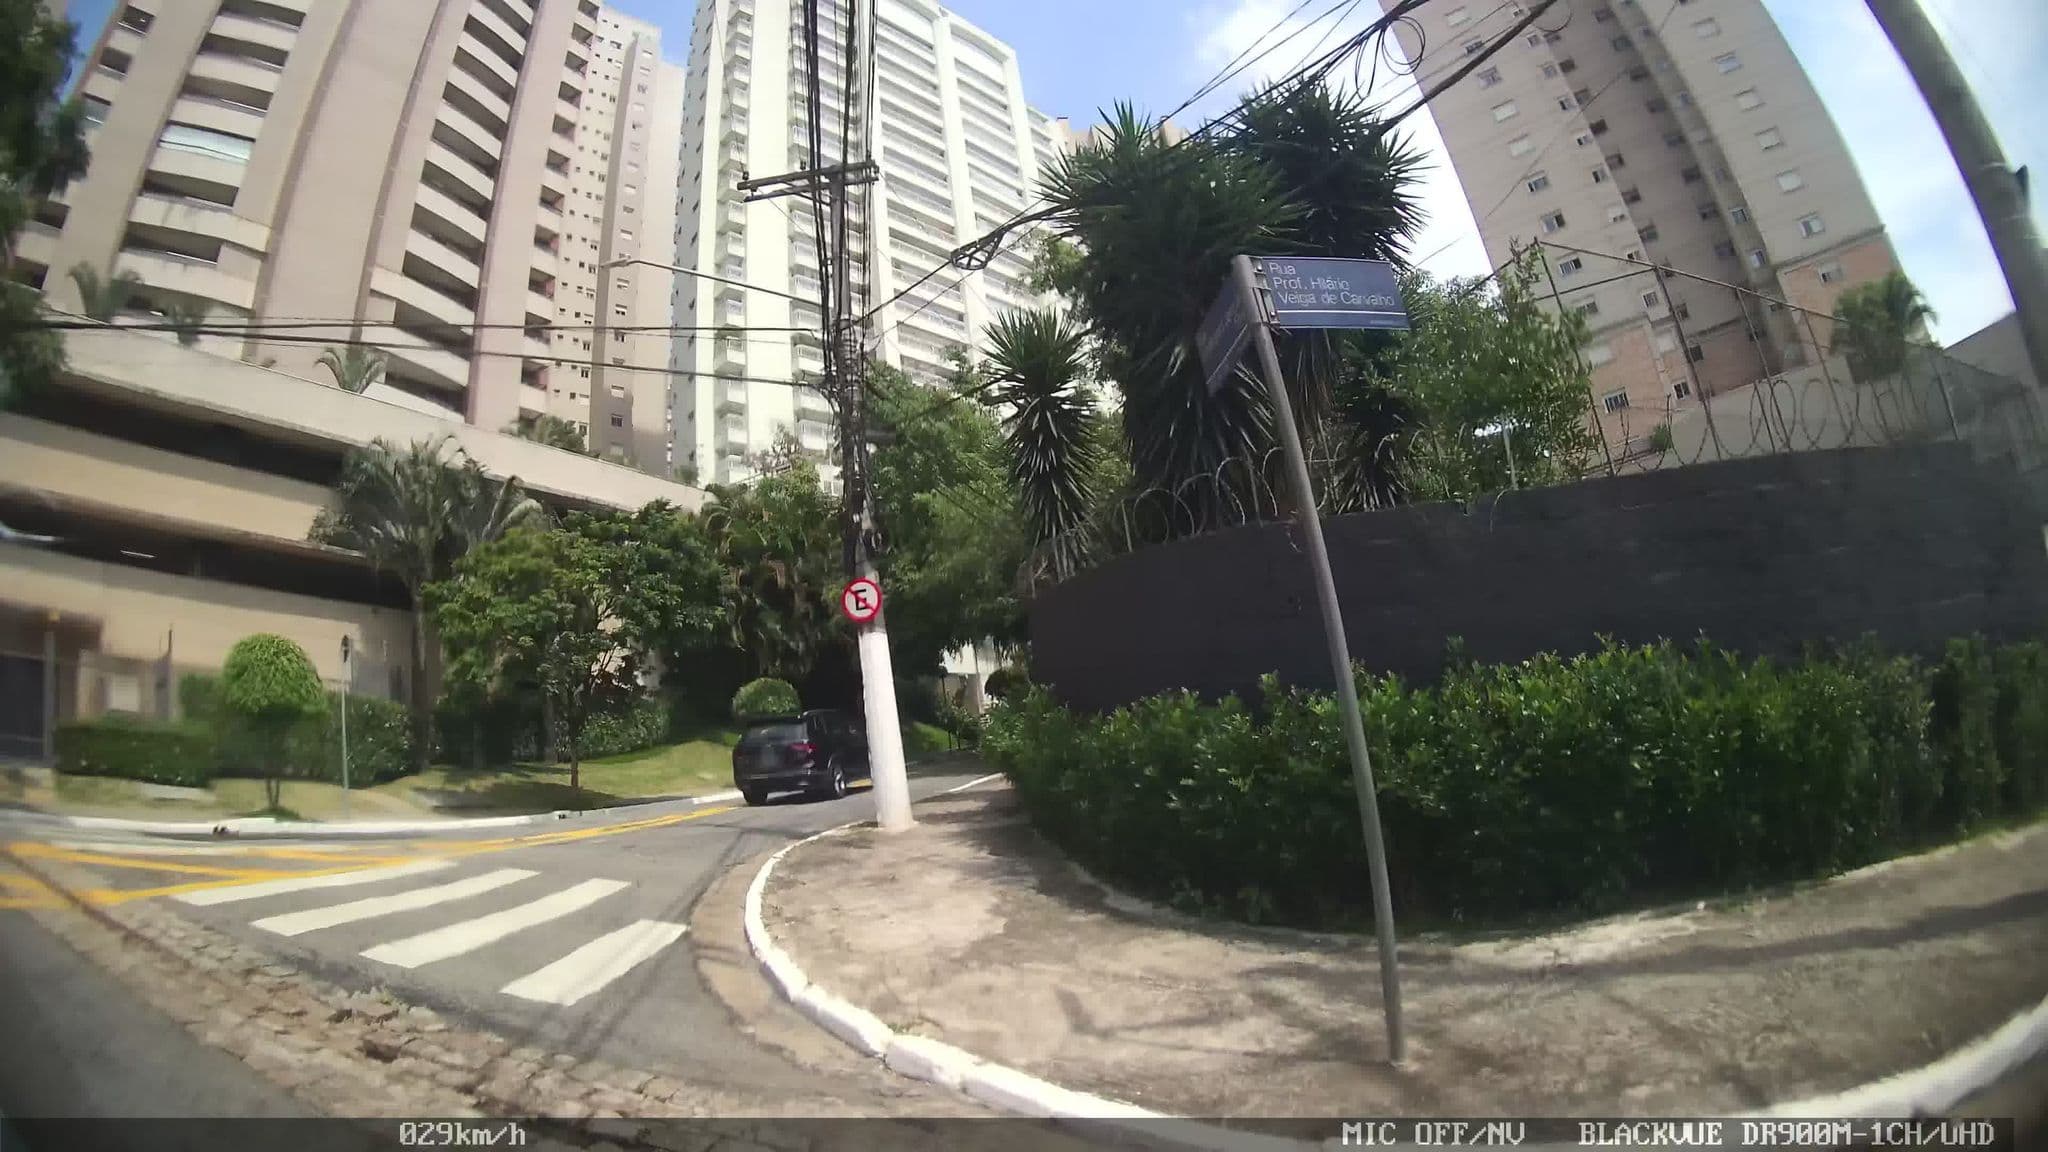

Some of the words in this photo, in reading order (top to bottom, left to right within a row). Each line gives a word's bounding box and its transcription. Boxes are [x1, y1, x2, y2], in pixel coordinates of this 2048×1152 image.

[1269, 262, 1296, 275] Rua
[1273, 277, 1307, 290] Prof.
[1311, 276, 1350, 290] Hilário
[1277, 292, 1317, 306] Veiga
[1321, 292, 1337, 305] de
[854, 589, 868, 610] E
